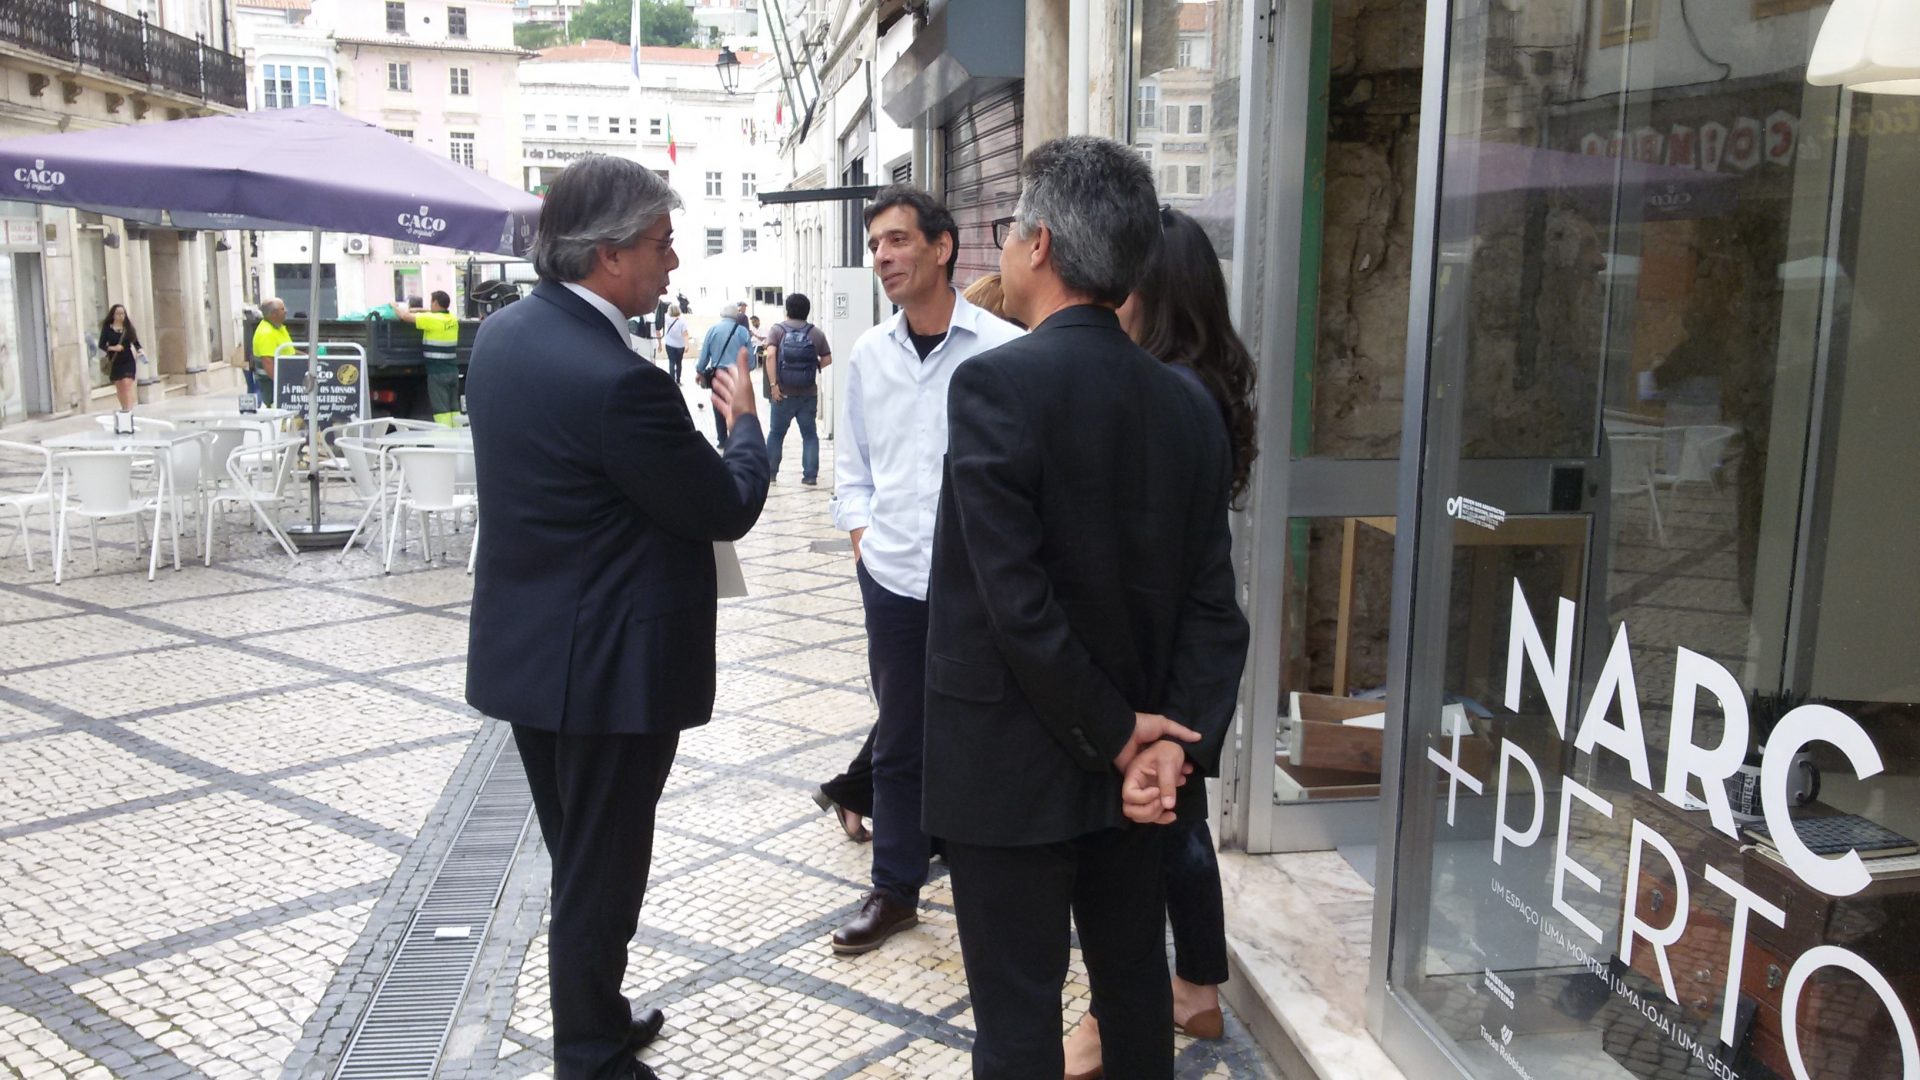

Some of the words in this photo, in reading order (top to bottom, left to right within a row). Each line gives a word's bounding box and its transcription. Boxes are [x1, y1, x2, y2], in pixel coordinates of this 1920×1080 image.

[529, 148, 544, 158] de
[14, 168, 65, 185] CACO
[397, 213, 446, 232] CACO
[1504, 576, 1884, 897] NARC
[1491, 878, 1504, 898] UM
[1505, 889, 1539, 925] ESPAÇO
[1544, 922, 1565, 948] UMA
[1567, 939, 1609, 985] MONTRA
[1616, 978, 1640, 1010] UMA
[1641, 999, 1670, 1035] LOJA
[1678, 1028, 1704, 1063] UMA
[1484, 977, 1515, 1010] MONTEIRO
[1480, 1024, 1499, 1052] Tintas
